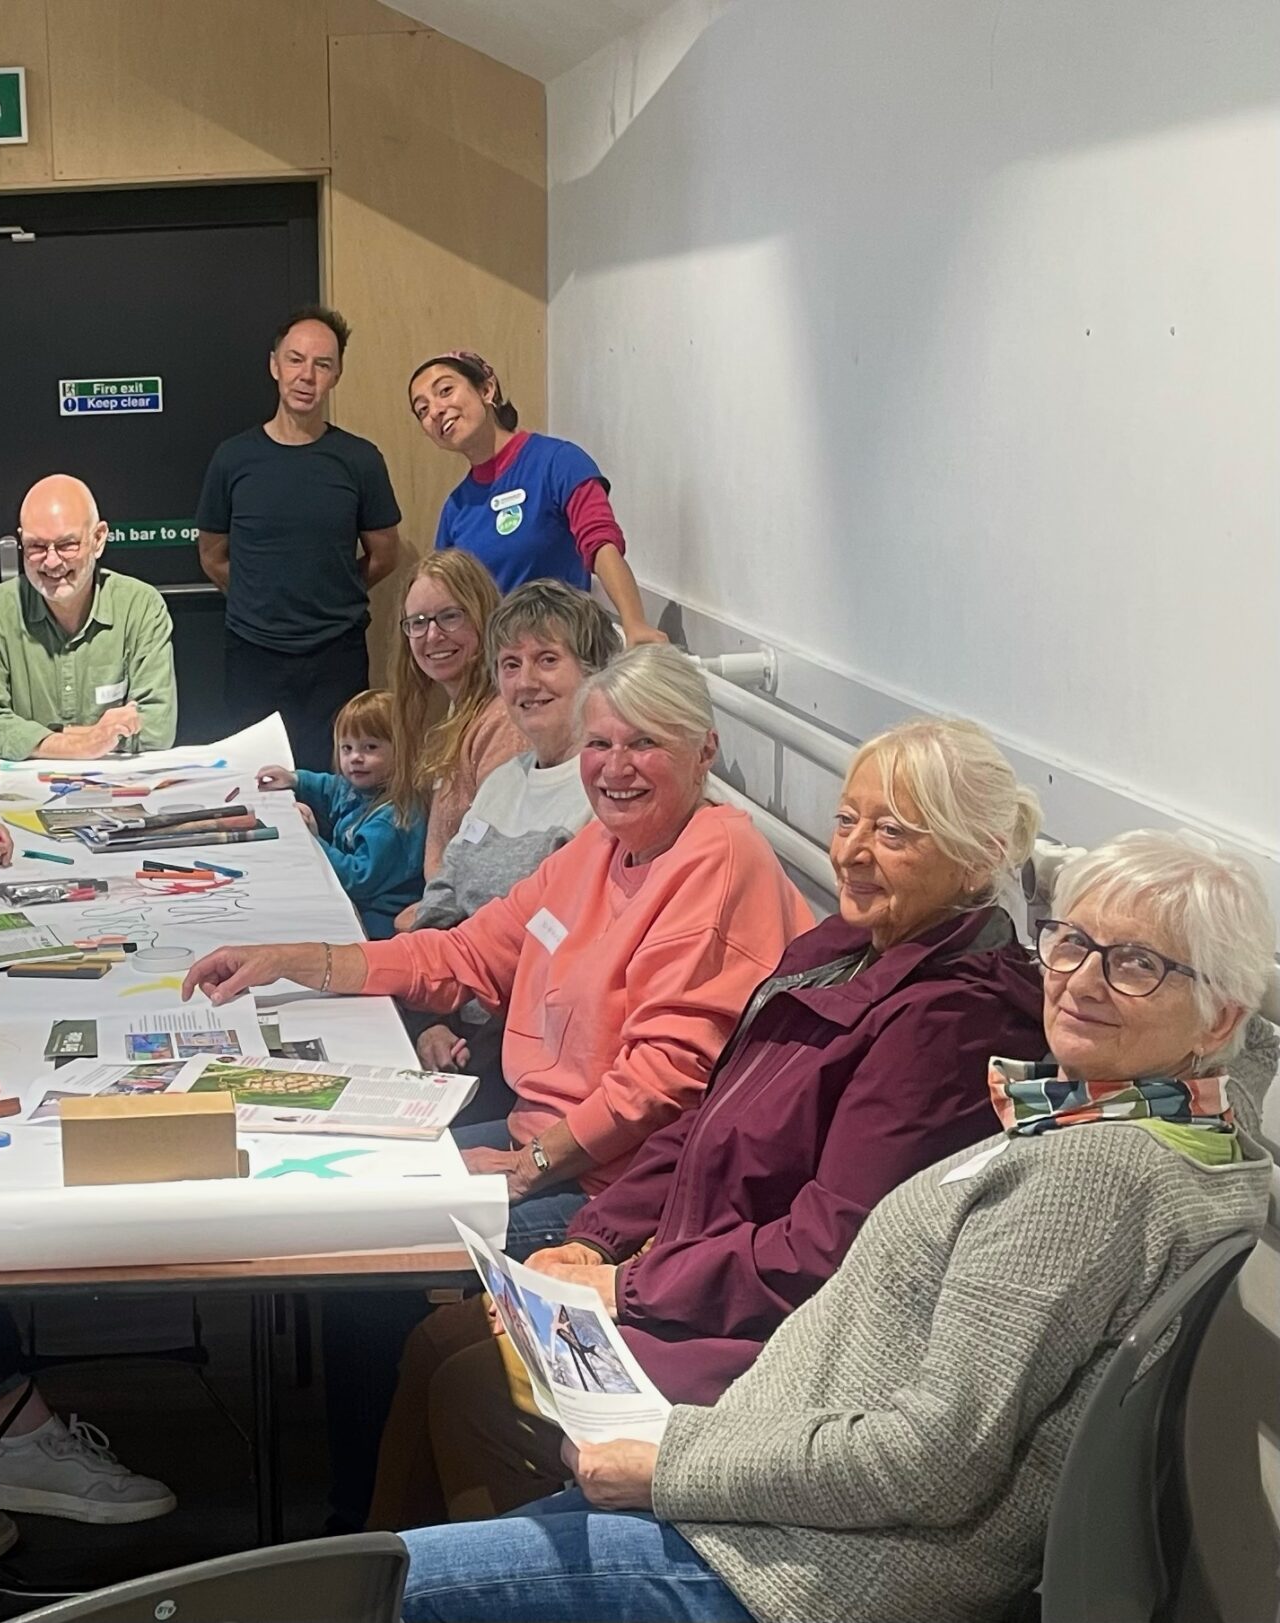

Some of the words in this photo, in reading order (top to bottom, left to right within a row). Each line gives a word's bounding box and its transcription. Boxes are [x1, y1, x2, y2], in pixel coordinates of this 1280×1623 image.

[93, 384, 118, 395] Fire
[120, 382, 144, 394] exit
[87, 398, 118, 410] Keep
[120, 397, 151, 408] clear
[107, 529, 126, 542] sh
[129, 528, 157, 541] bar
[160, 527, 177, 539] to
[180, 527, 200, 541] op
